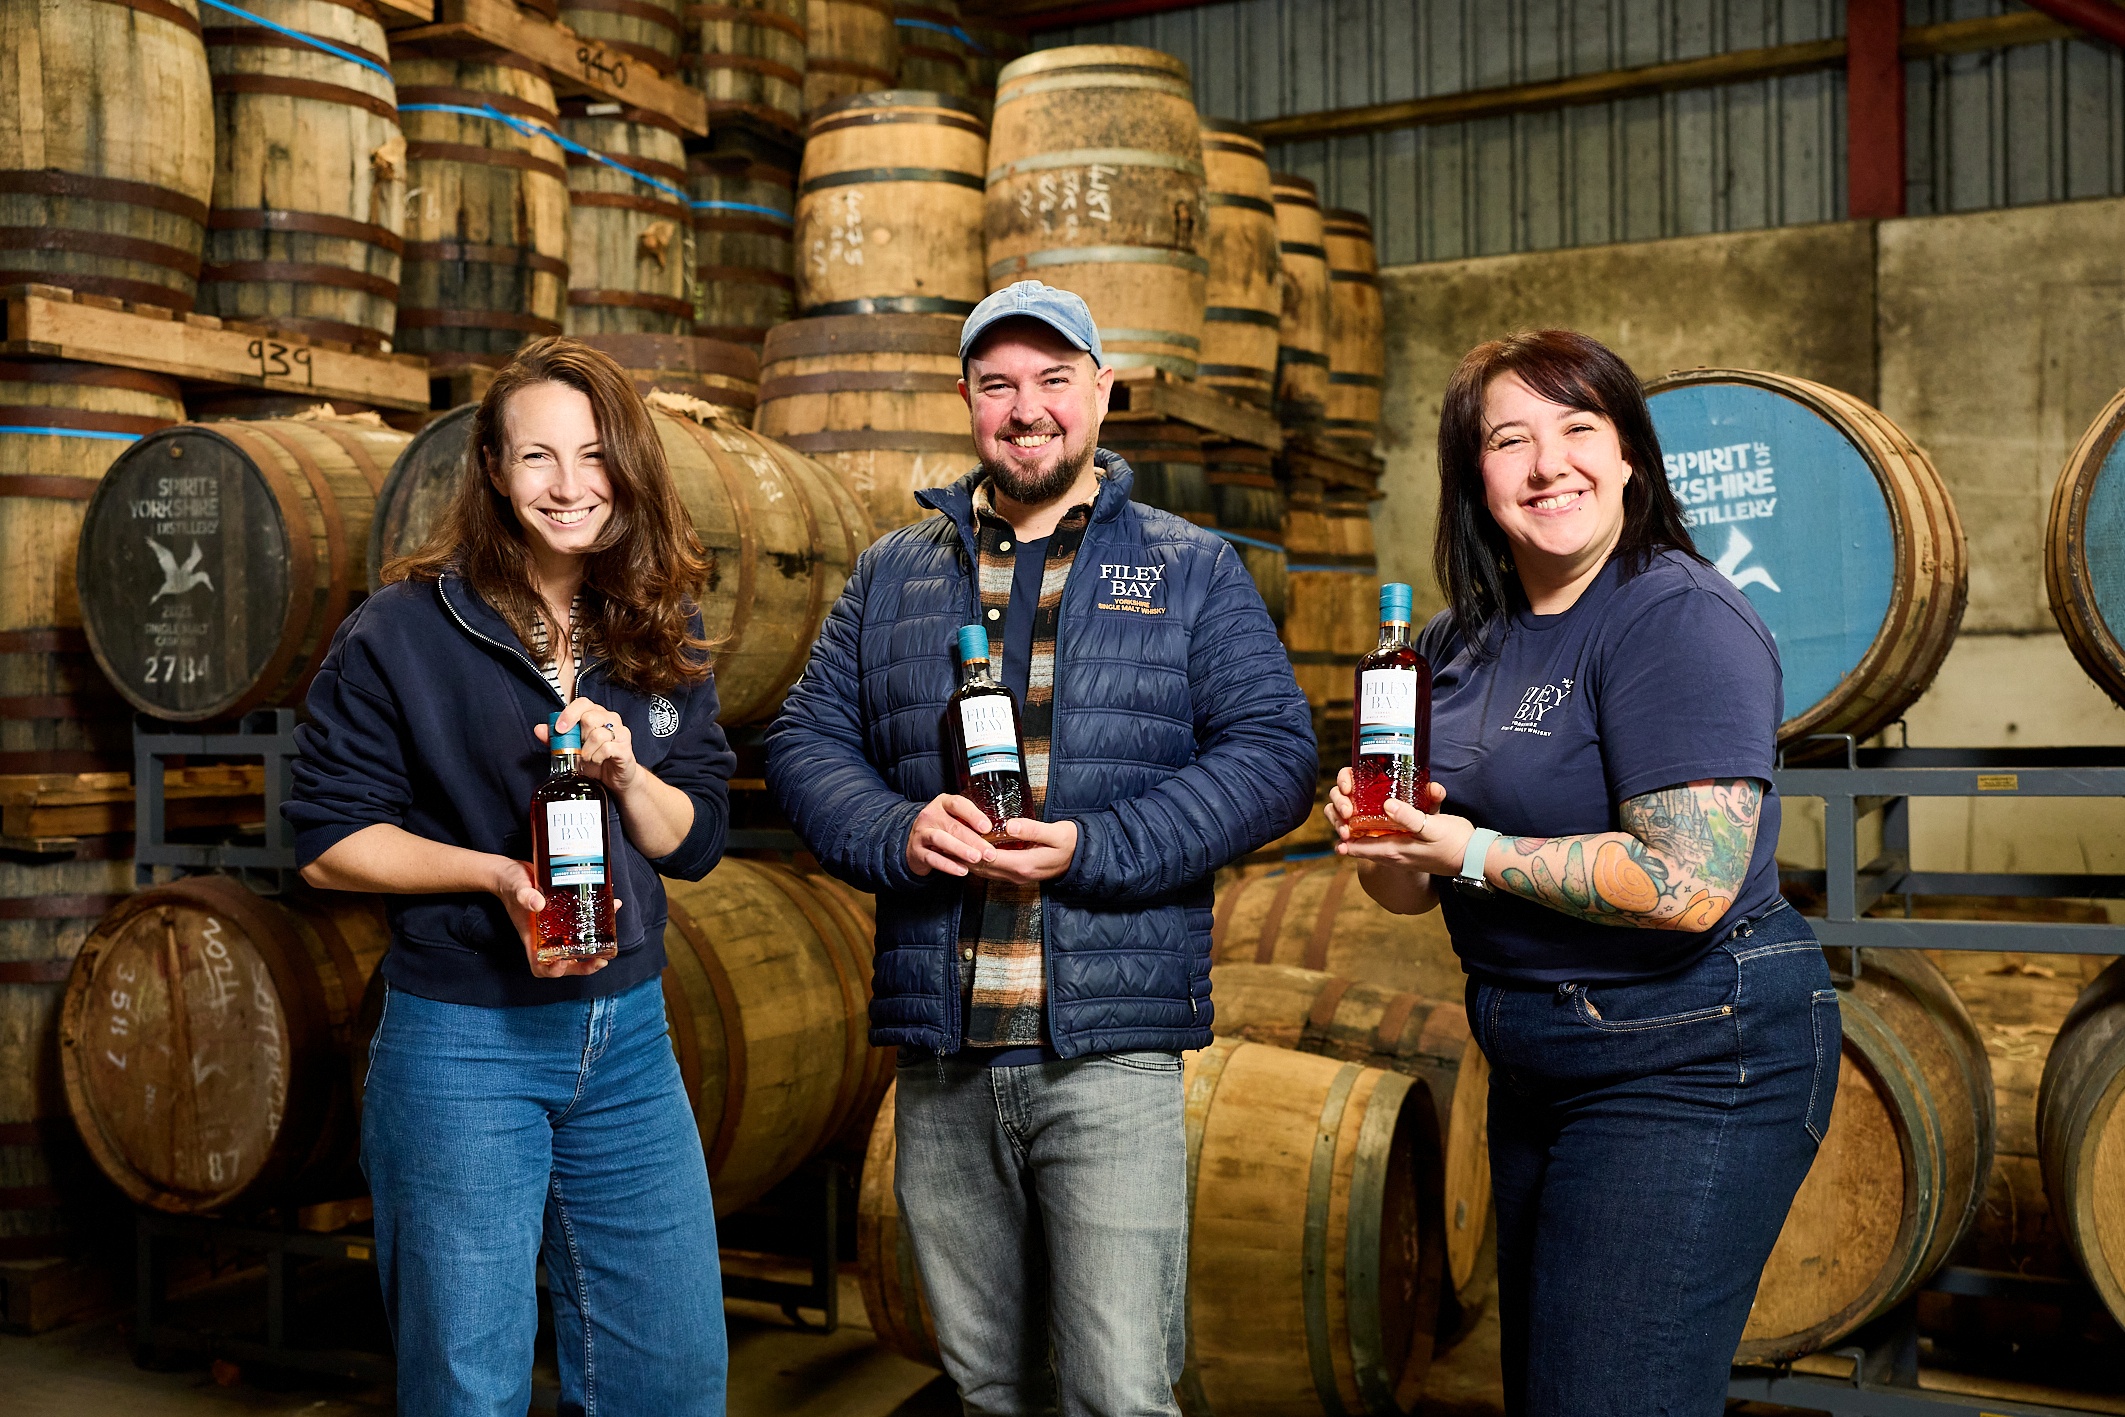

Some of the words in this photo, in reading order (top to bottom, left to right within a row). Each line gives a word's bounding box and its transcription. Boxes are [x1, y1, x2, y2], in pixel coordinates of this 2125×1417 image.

[576, 47, 628, 89] 940
[247, 340, 312, 387] 939
[1663, 443, 1751, 480] SPIRIT
[1753, 442, 1771, 466] OF
[158, 477, 207, 497] SPIRIT
[1669, 467, 1776, 505] KSHIRE
[128, 498, 219, 518] YORKSHIRE
[1678, 498, 1777, 528] STILLERY
[1100, 564, 1165, 581] FILEY
[1110, 580, 1156, 598] BAY
[1098, 603, 1120, 611] SINGLE
[1141, 607, 1166, 615] WHISKY
[1114, 598, 1150, 608] YORKSHIRE
[1366, 682, 1411, 695] FILEY
[967, 706, 1009, 721] FILEY
[1514, 702, 1553, 721] BAY
[975, 718, 1005, 733] BAY
[553, 812, 598, 827] FILEY
[561, 827, 592, 840] BAY
